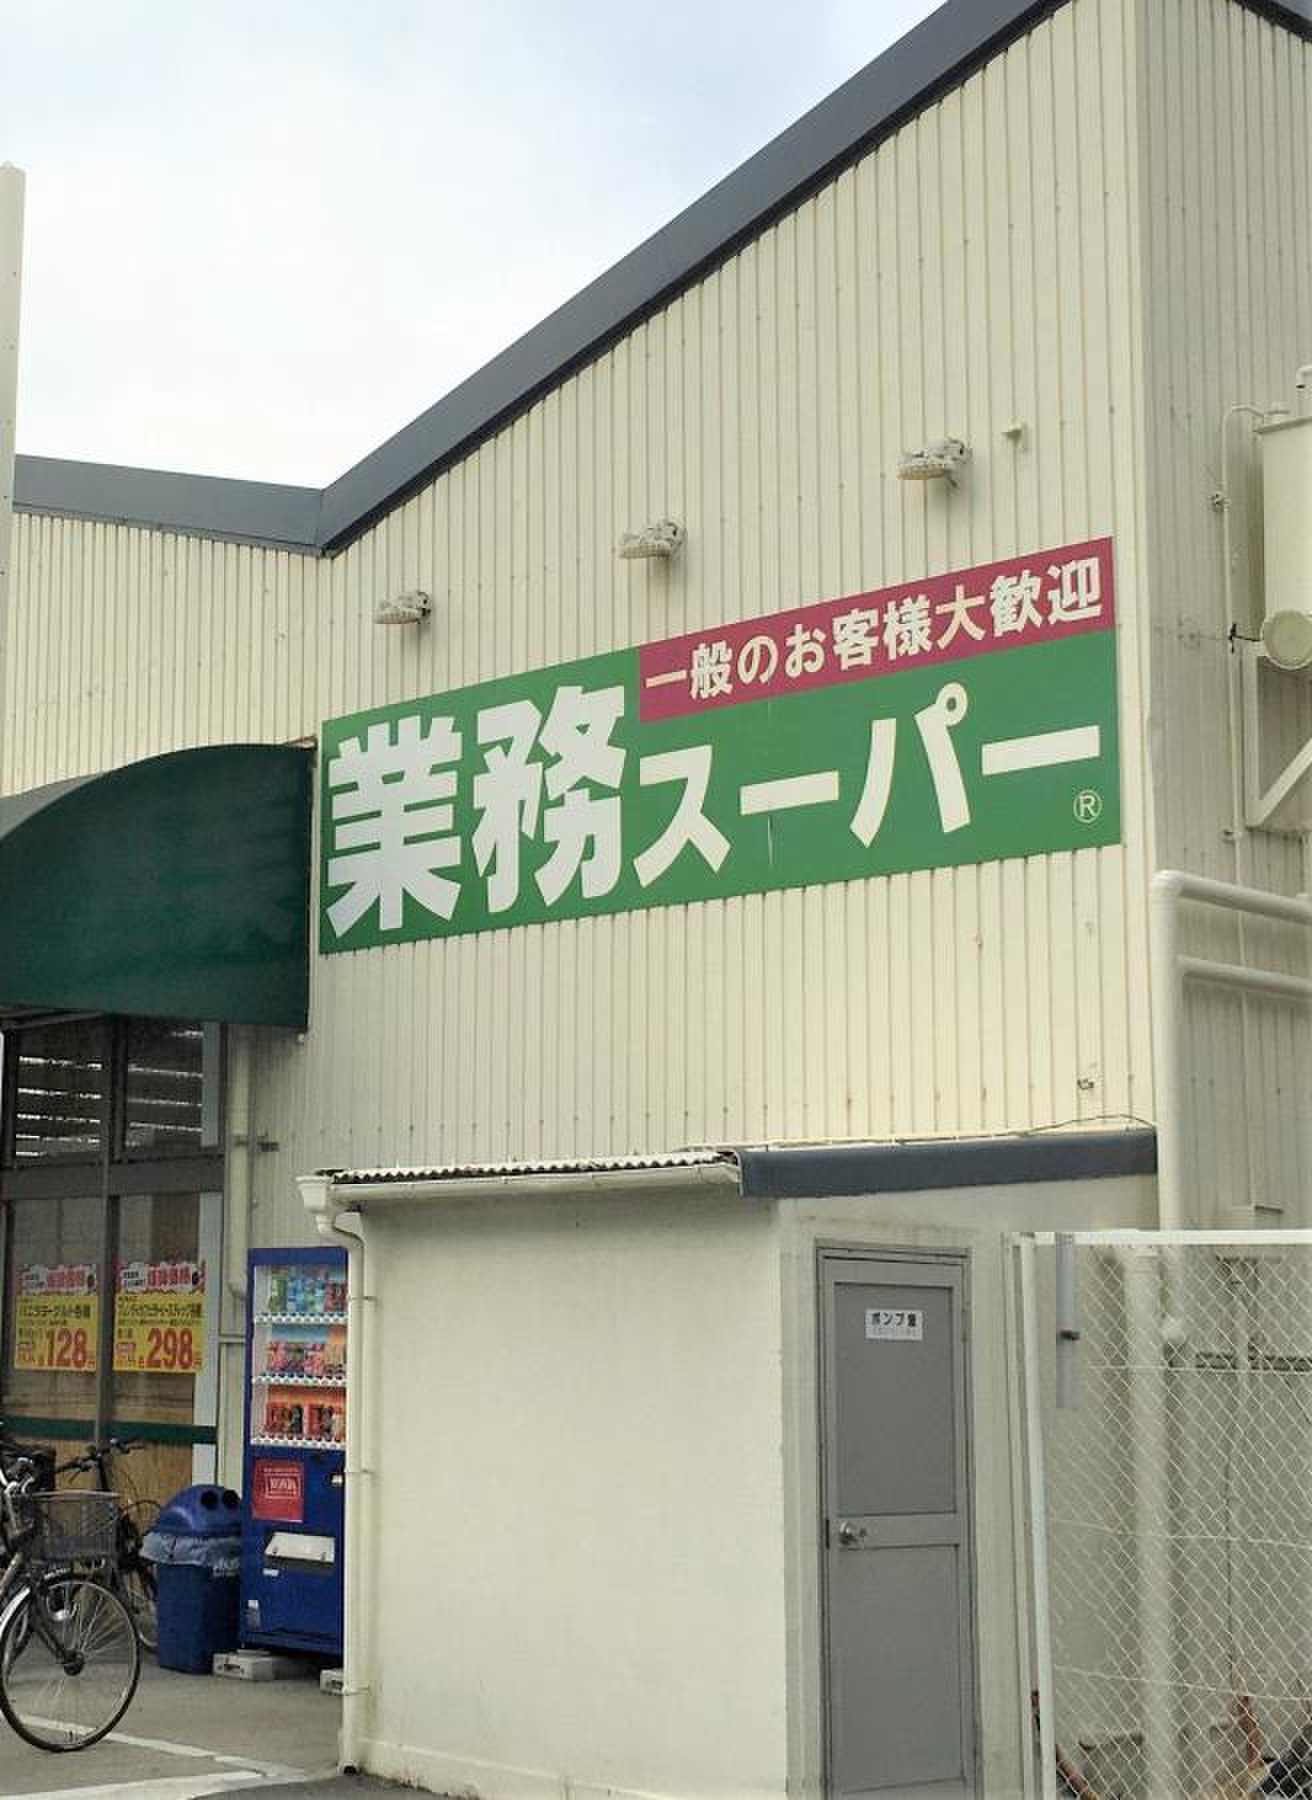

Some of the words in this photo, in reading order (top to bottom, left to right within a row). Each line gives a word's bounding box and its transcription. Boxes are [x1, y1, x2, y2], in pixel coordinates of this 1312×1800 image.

[644, 556, 1103, 702] 一般のお客様大歓迎
[326, 681, 1101, 938] 業務スーパー
[147, 1327, 193, 1369] 298
